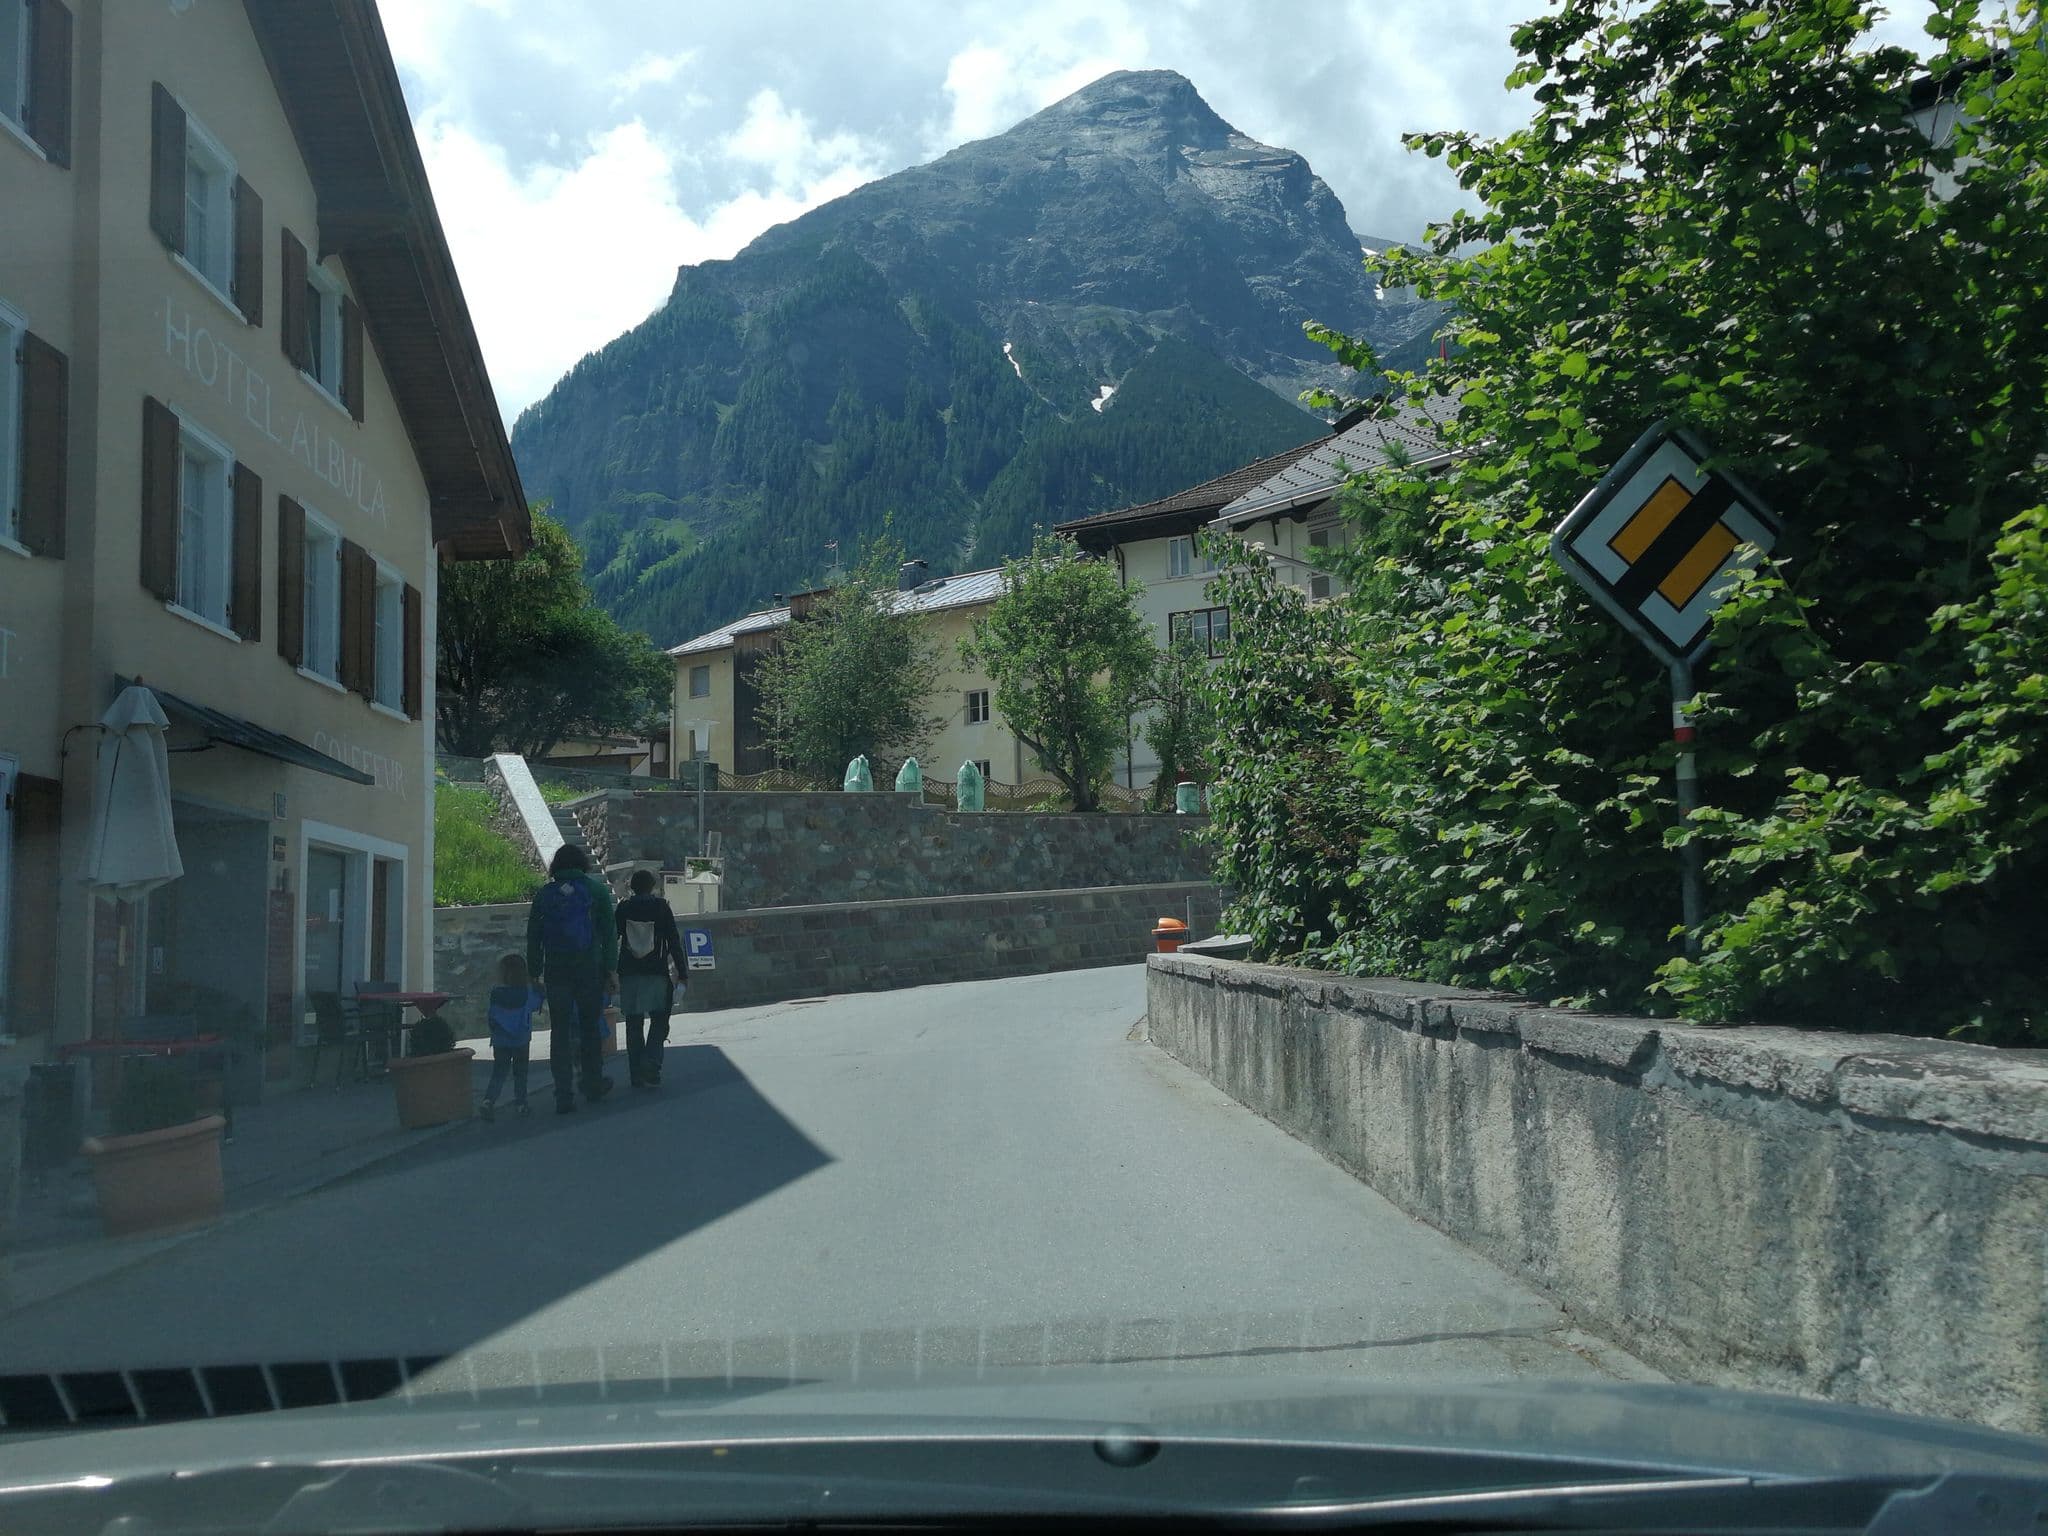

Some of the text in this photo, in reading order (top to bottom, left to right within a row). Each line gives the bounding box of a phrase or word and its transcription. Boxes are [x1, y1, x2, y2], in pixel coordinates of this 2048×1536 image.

[165, 295, 388, 529] HOTEL ALBULA
[690, 932, 708, 954] P
